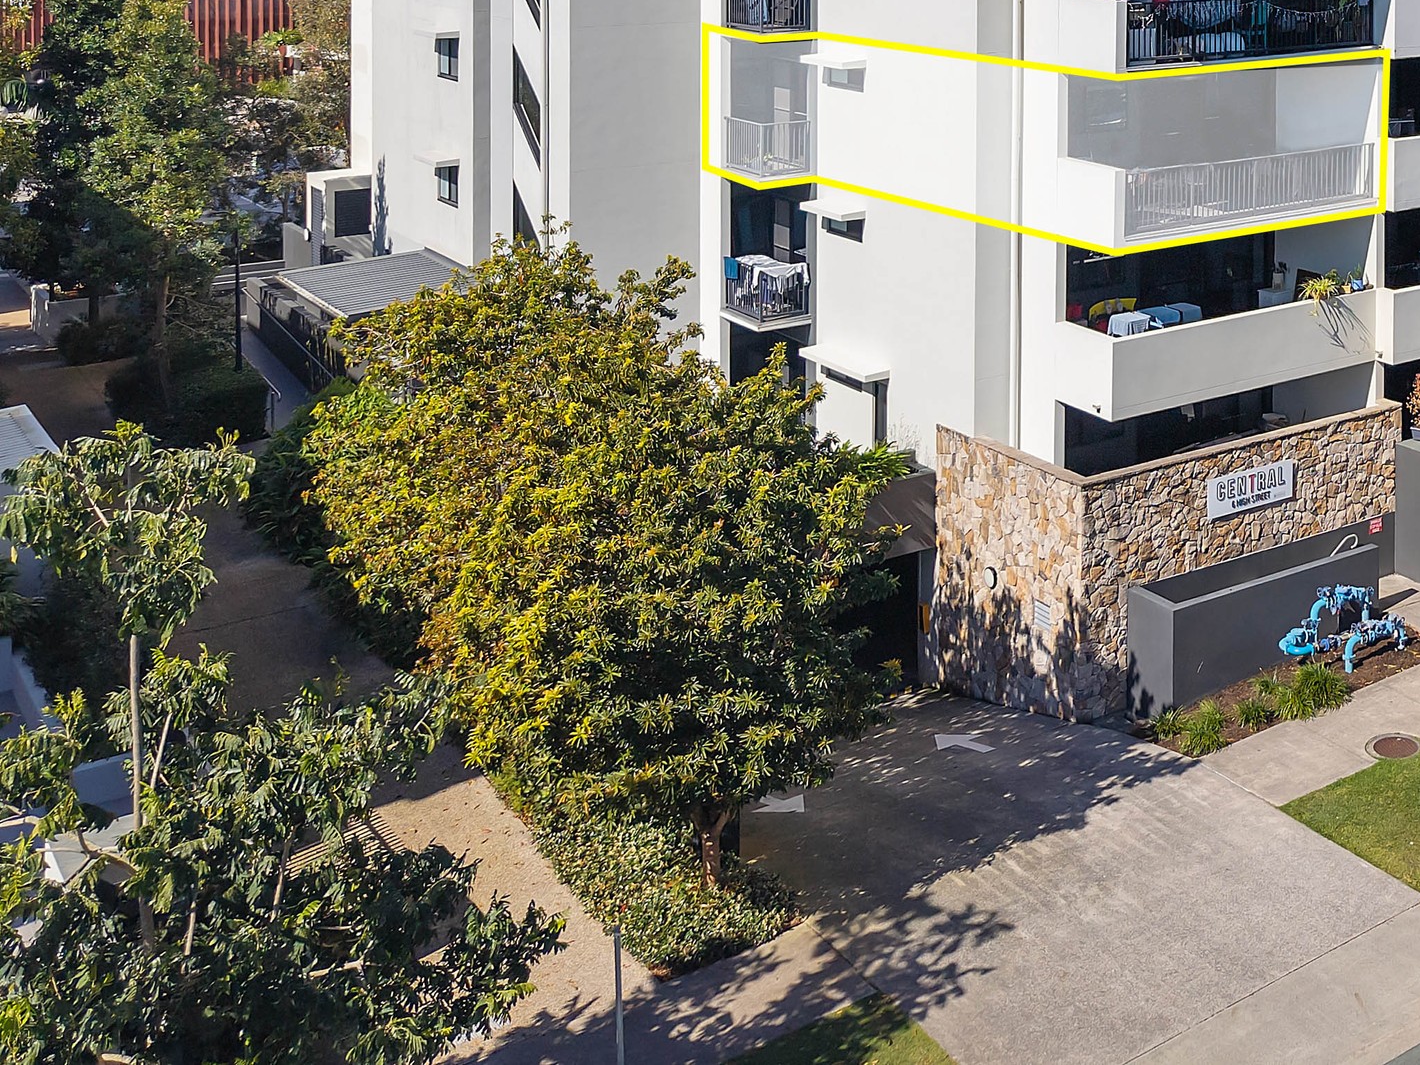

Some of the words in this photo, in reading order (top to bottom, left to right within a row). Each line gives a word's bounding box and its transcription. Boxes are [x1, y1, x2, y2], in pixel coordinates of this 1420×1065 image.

[1216, 466, 1286, 502] CENTRAL
[1236, 497, 1251, 508] HIGH
[1251, 491, 1271, 504] STREET
